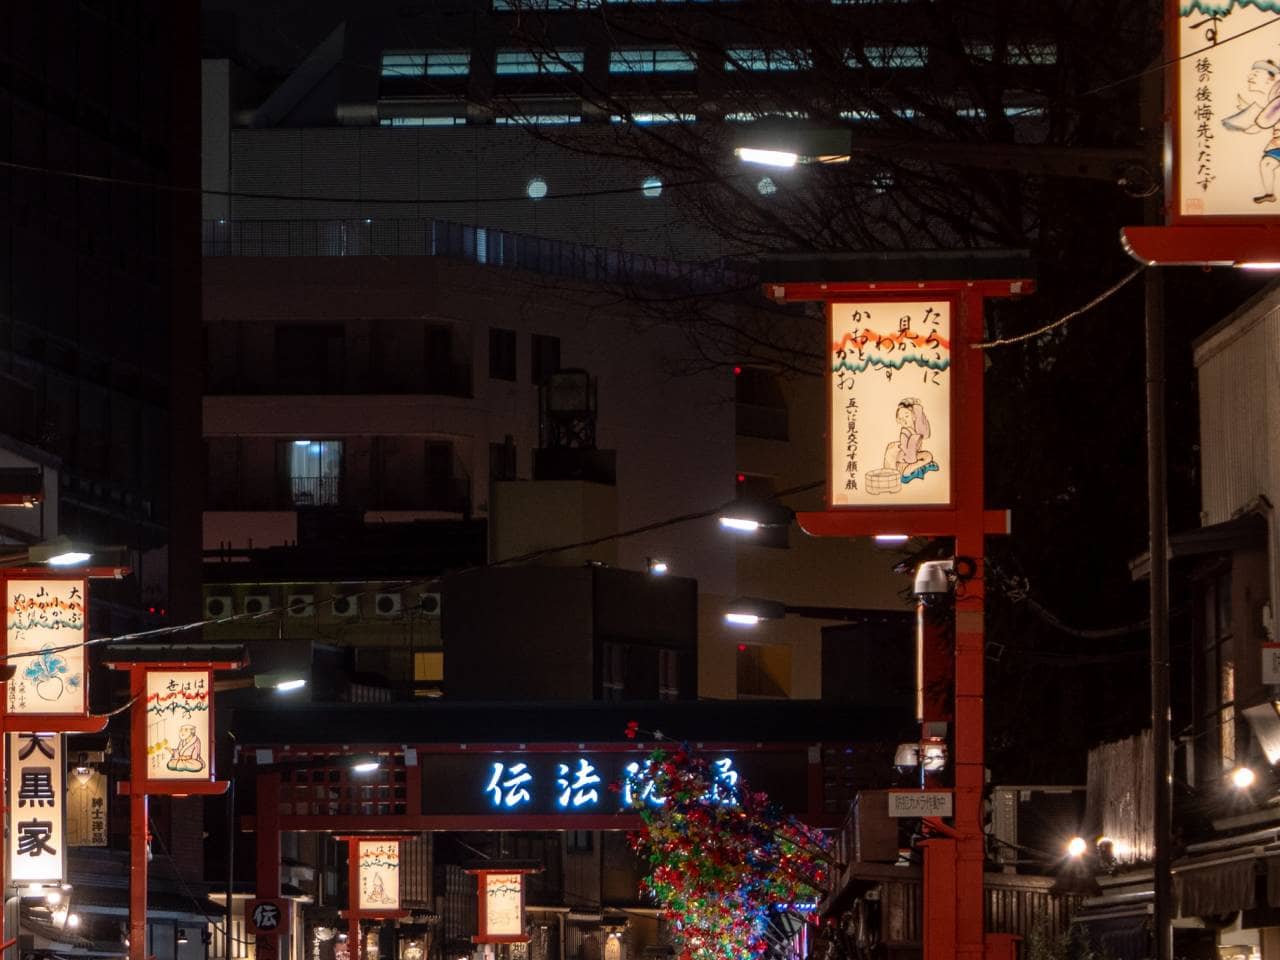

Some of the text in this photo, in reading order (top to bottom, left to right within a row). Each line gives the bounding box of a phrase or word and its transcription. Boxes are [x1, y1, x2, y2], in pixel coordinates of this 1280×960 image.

[17, 735, 57, 857] 大黒家
[254, 905, 277, 929] 伝
